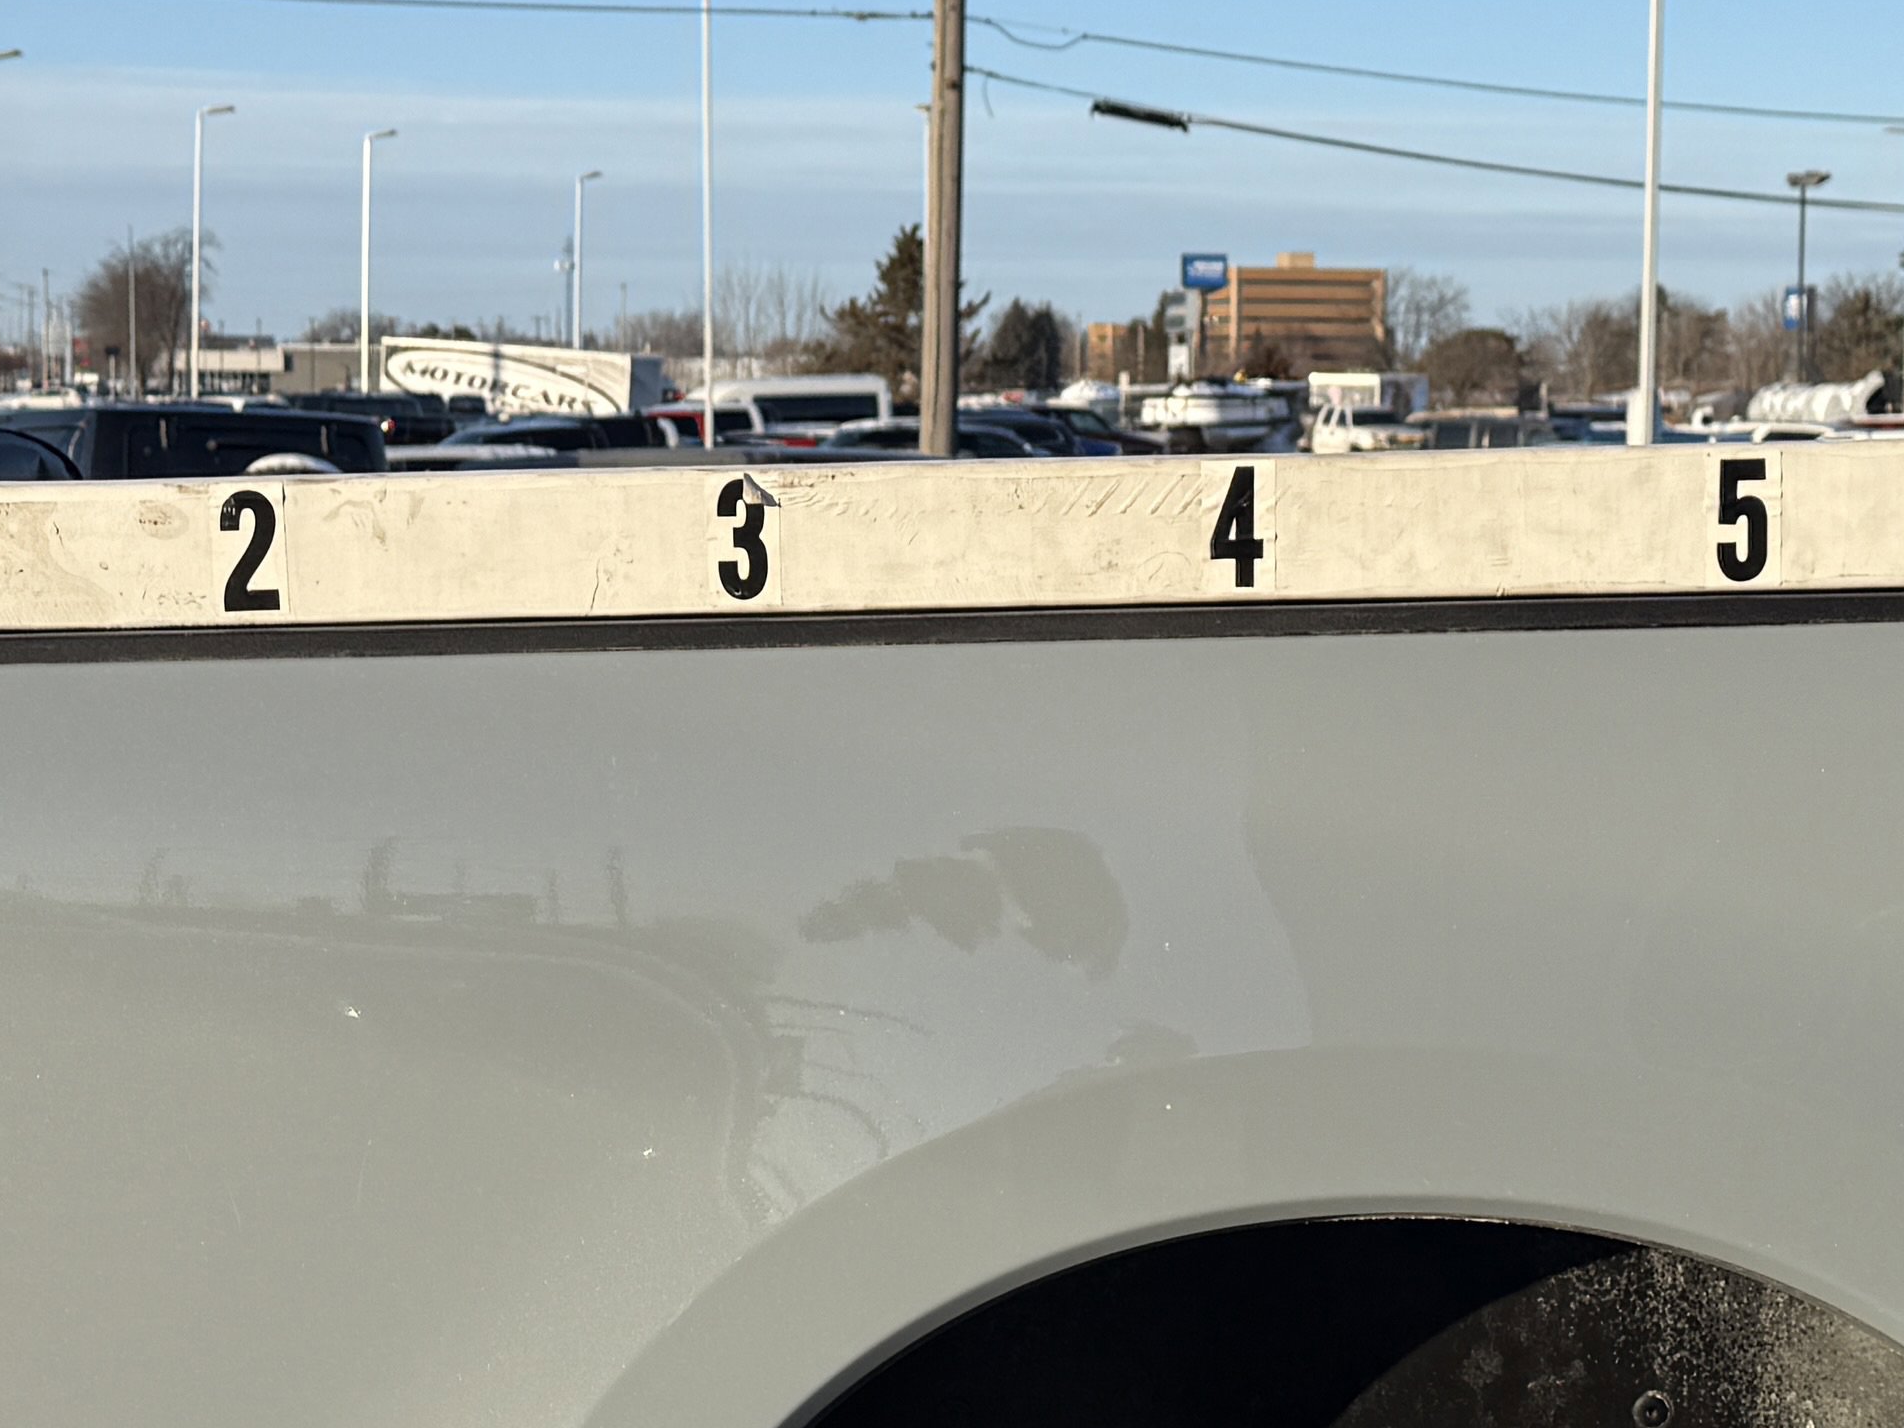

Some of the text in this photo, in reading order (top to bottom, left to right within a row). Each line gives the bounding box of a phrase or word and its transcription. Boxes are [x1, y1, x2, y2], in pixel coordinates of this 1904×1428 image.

[219, 489, 281, 612] 2
[716, 477, 770, 601] 3
[1210, 466, 1264, 588] 4
[1716, 458, 1768, 582] 5
